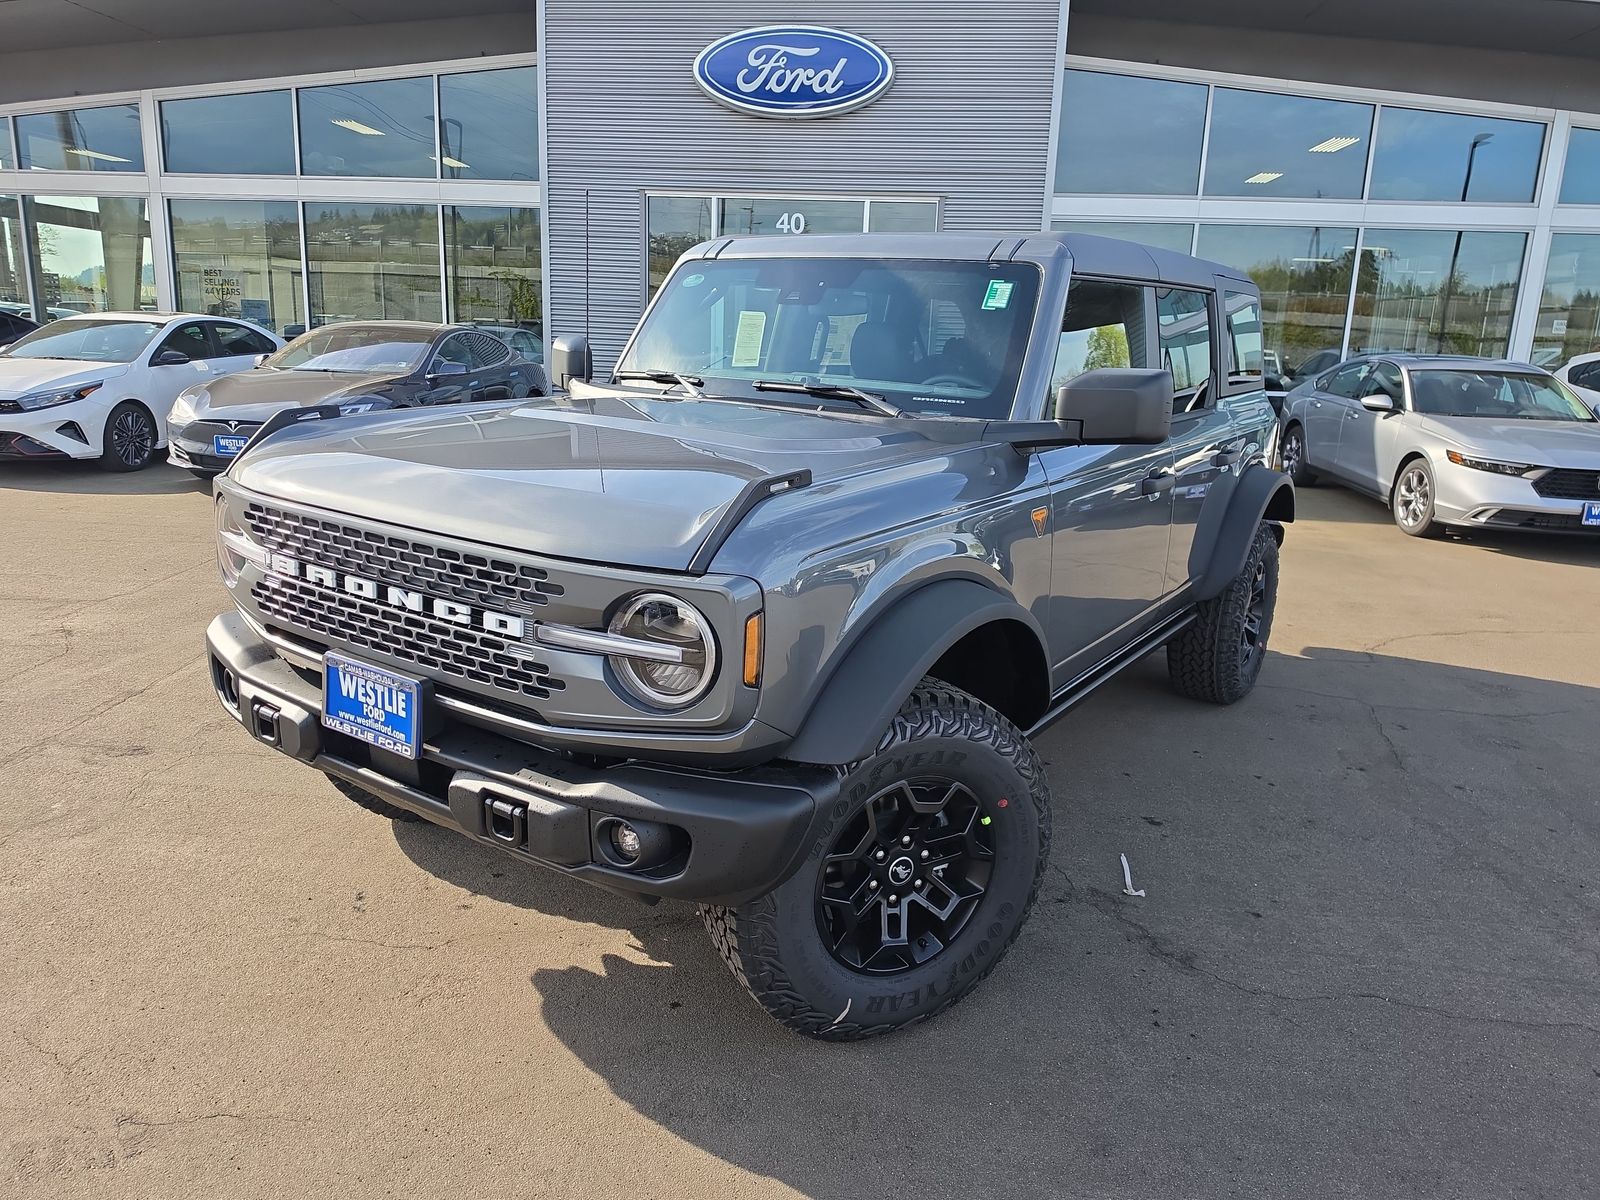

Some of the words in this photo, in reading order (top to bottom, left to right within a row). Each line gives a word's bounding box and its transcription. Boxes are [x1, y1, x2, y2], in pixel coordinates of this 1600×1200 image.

[736, 44, 848, 94] Ford
[775, 212, 805, 234] 40
[204, 269, 223, 277] BEST
[204, 278, 235, 287] SELLING
[215, 287, 241, 296] YEARS
[219, 438, 246, 447] WESTLIE
[271, 553, 524, 638] BRONCO
[339, 670, 406, 718] WESTLIE
[338, 710, 406, 741] www.westlieford.com
[363, 703, 386, 722] FORD
[325, 716, 375, 742] WESTLIE
[378, 736, 412, 756] FORD
[865, 902, 1014, 1013] GOODYEAR
